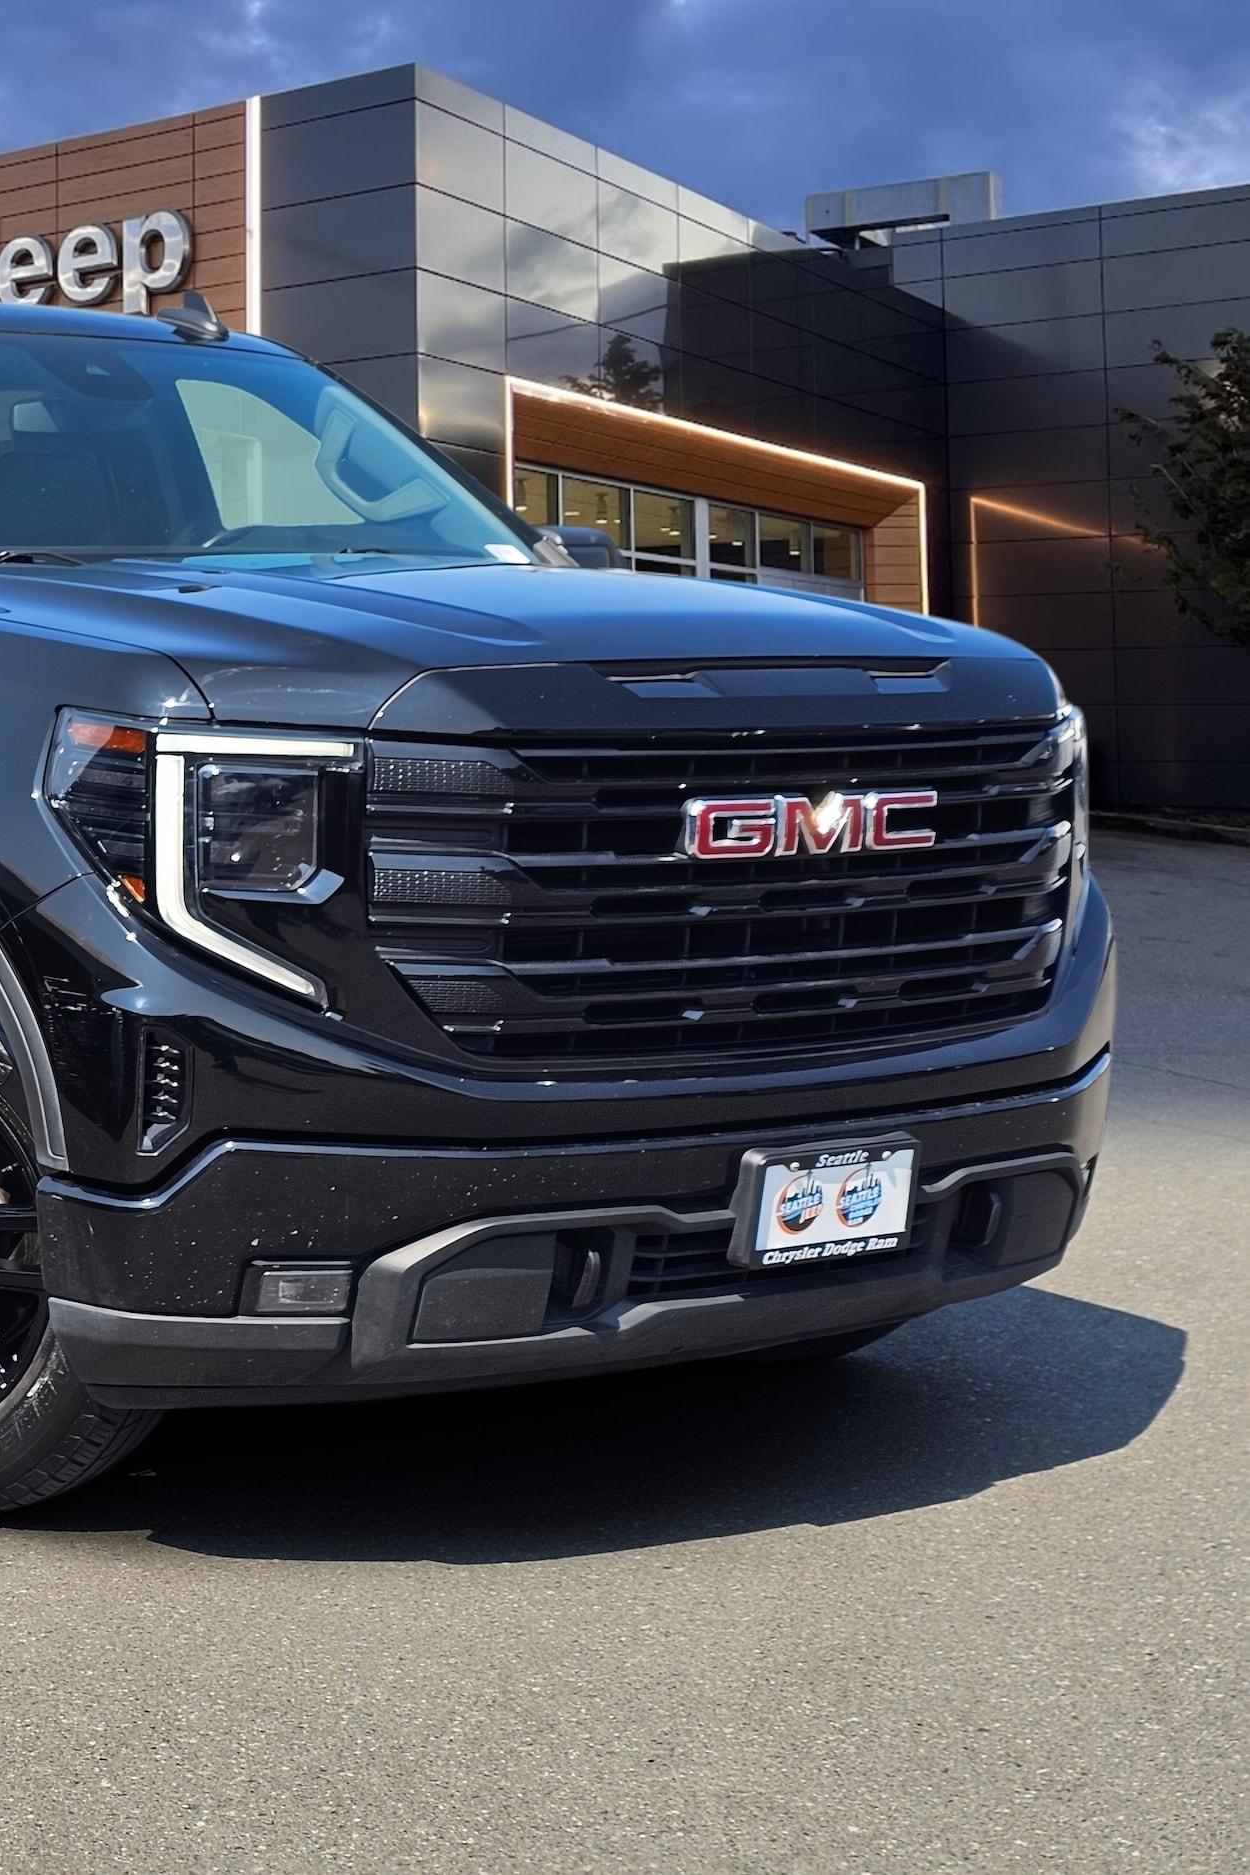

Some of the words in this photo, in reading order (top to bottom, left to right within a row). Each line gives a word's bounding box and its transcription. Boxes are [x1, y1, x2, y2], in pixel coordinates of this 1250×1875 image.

[685, 790, 938, 859] GMC
[815, 1149, 870, 1168] Seattle
[762, 1246, 823, 1265] Chrysler
[821, 1240, 866, 1257] Dodge
[865, 1236, 899, 1251] Ram
